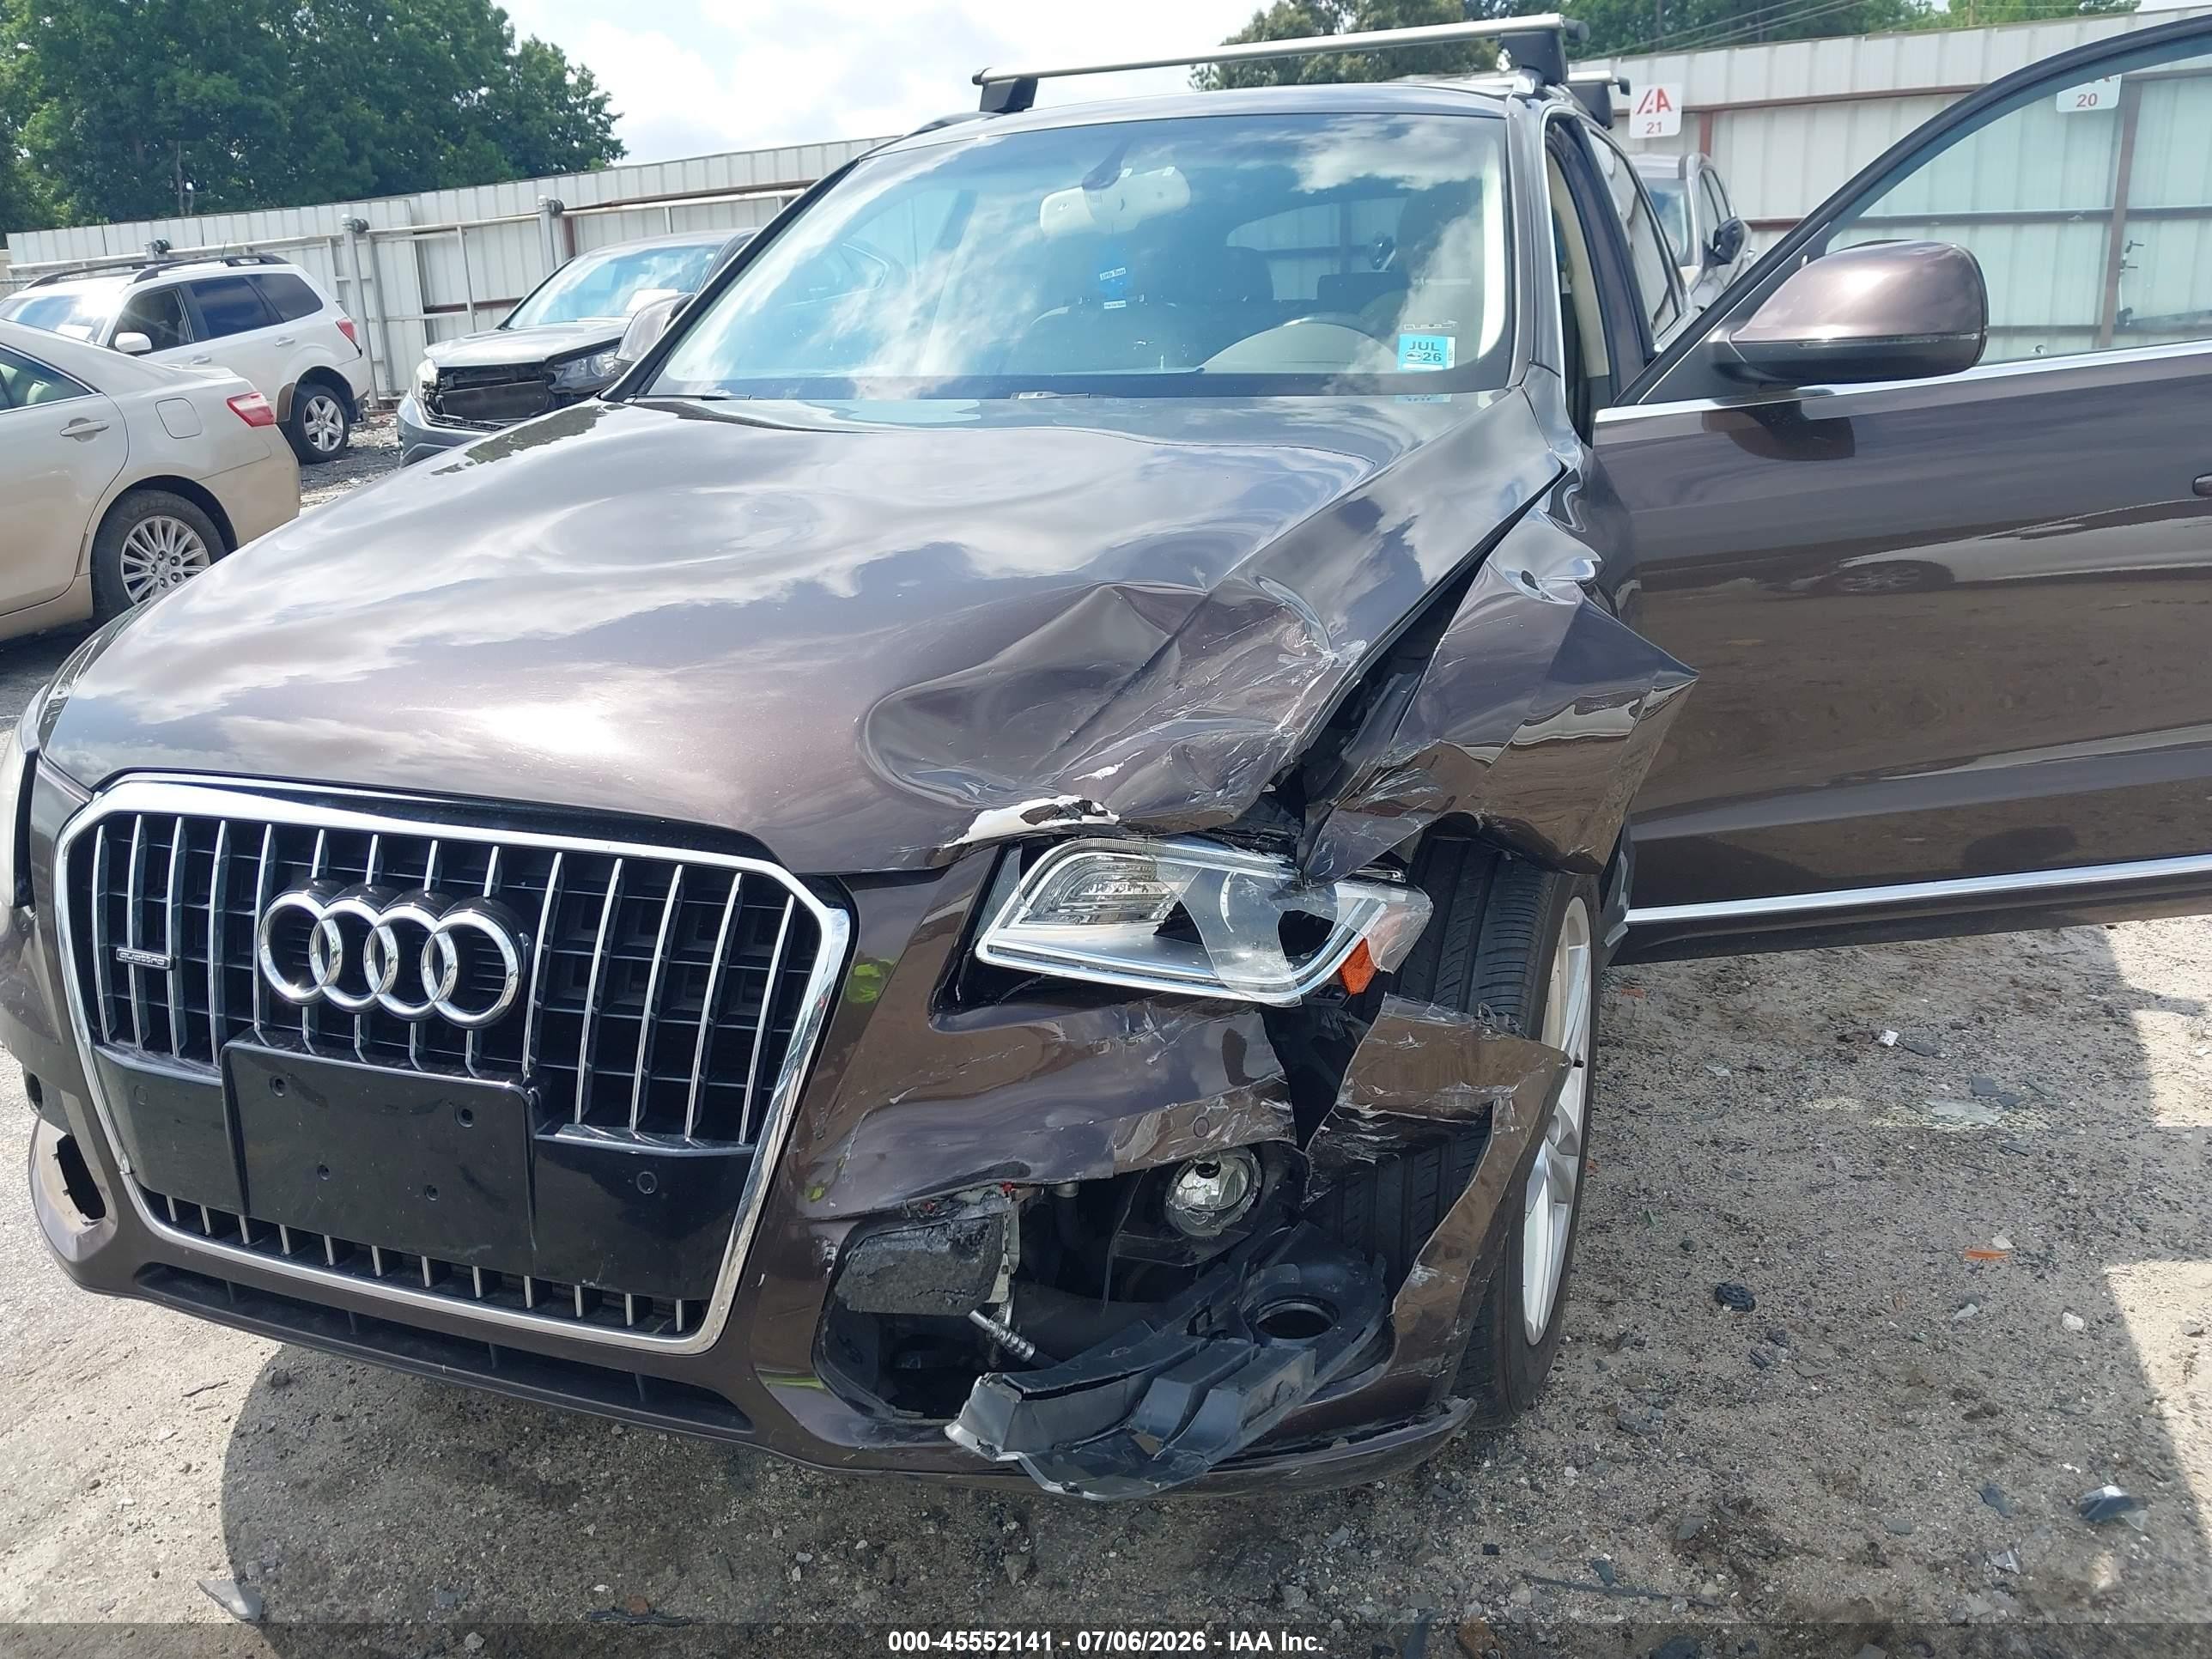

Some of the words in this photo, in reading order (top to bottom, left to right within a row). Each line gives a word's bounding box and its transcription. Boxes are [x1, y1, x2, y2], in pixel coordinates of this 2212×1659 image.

[2075, 93, 2098, 107] 20
[1645, 121, 1663, 135] 21
[1408, 341, 1440, 351] JUL
[1422, 351, 1442, 362] 26
[119, 951, 166, 966] quattro
